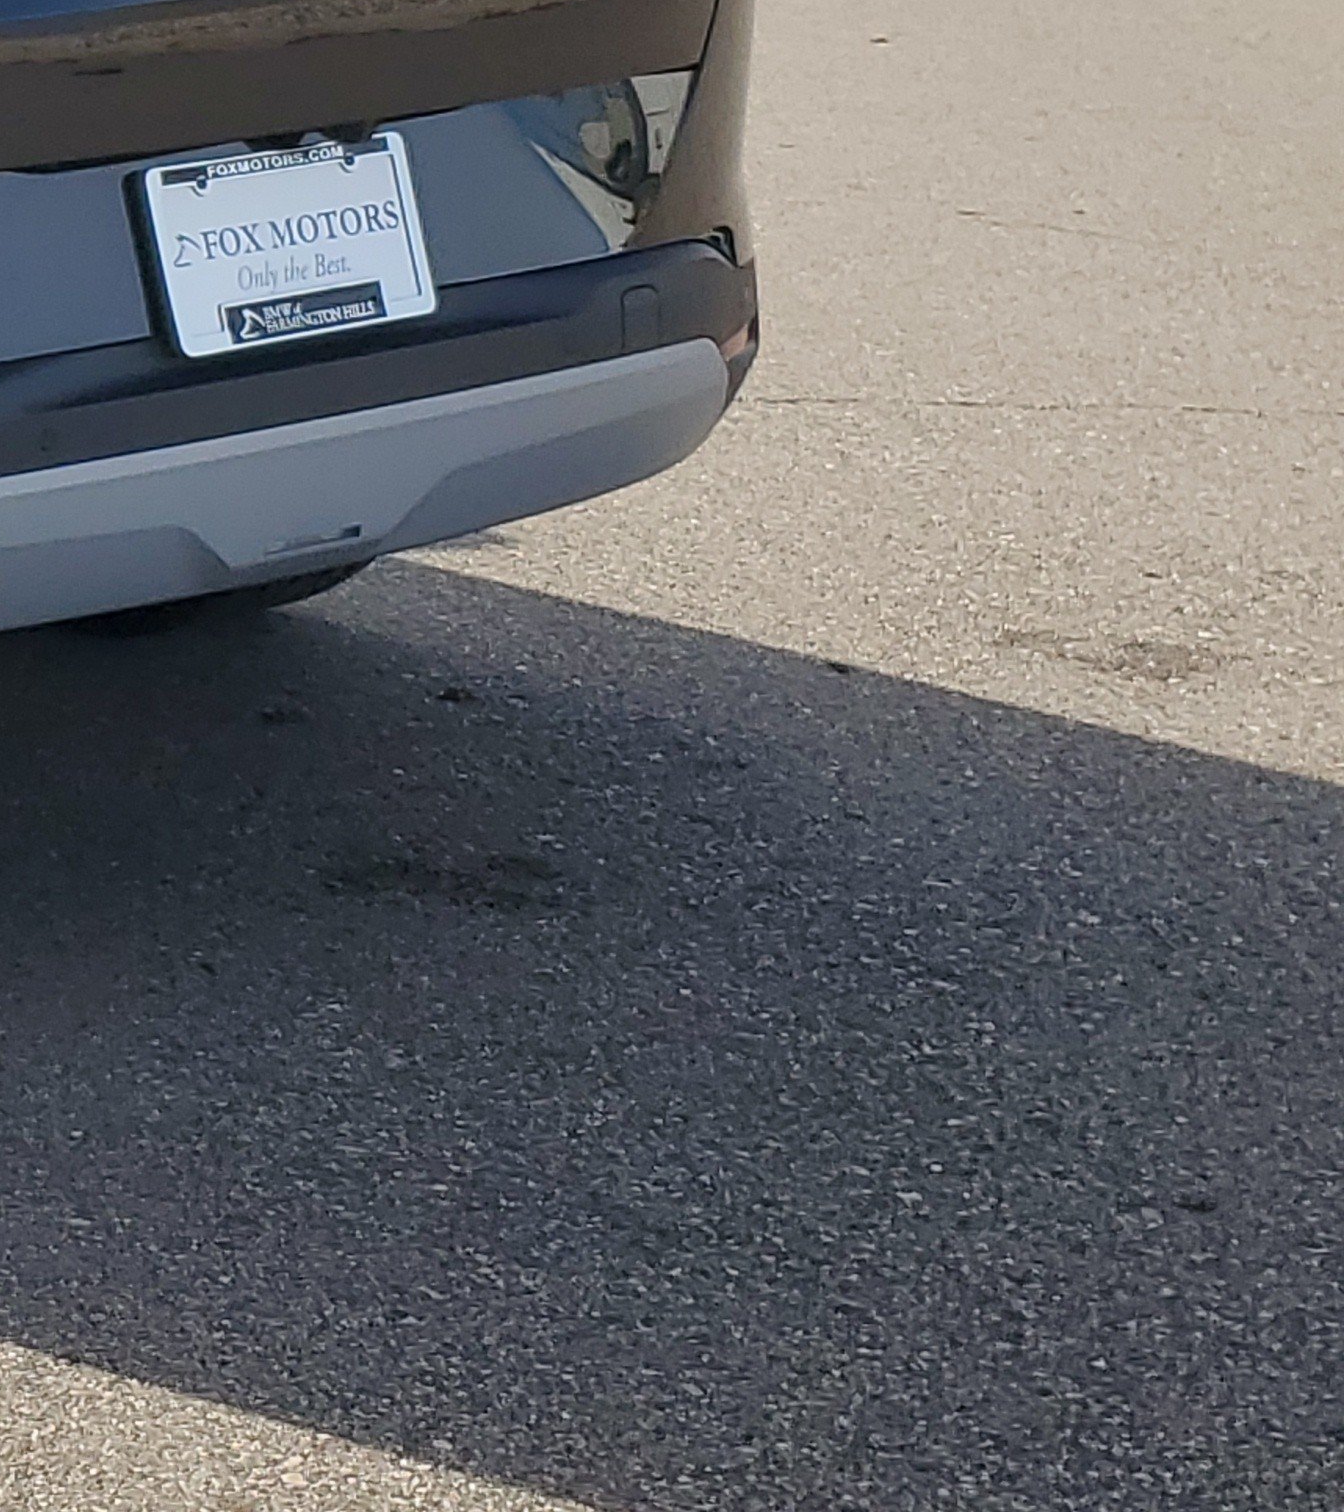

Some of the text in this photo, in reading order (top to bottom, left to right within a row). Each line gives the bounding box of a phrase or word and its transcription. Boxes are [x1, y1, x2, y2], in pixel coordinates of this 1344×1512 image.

[206, 145, 345, 179] FOXMOTORS.COM
[199, 200, 400, 261] FOX MOTORS
[237, 253, 352, 293] Only the Best.
[262, 302, 292, 320] BMW
[265, 299, 375, 333] FARMINGTON HILLS
